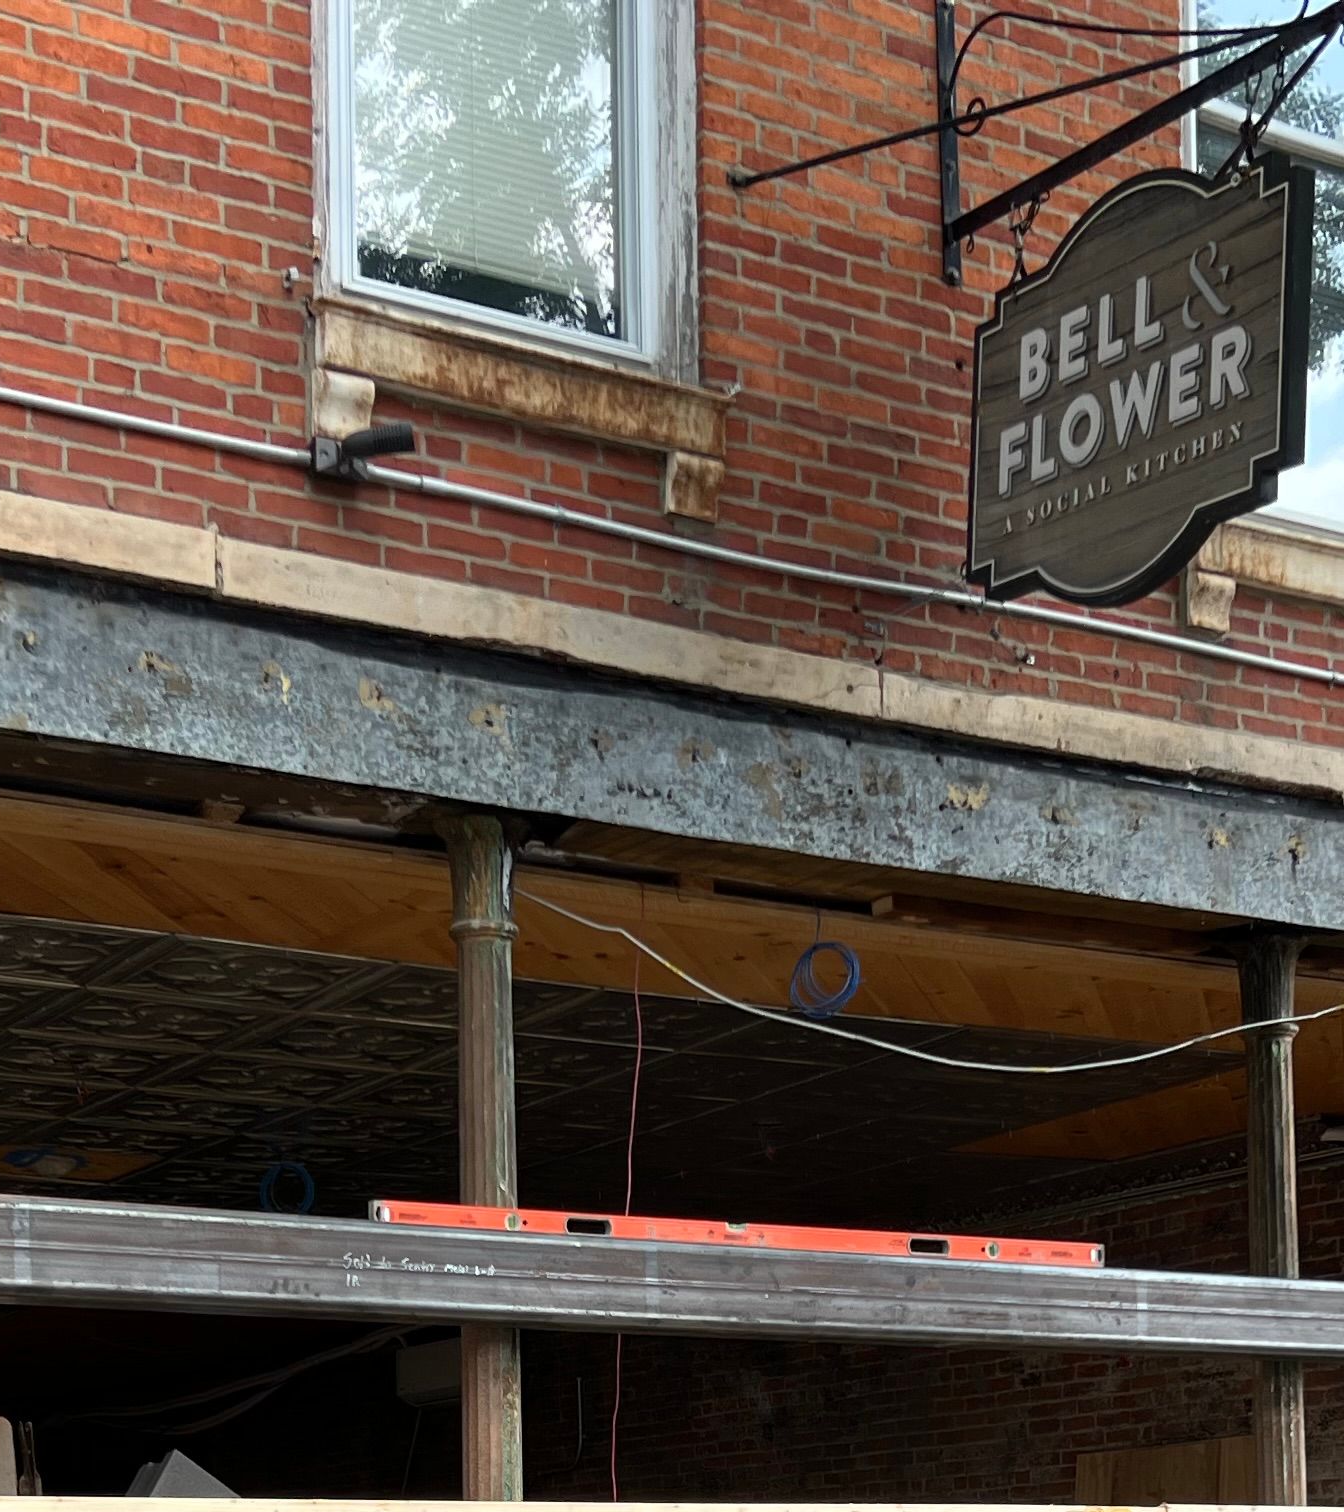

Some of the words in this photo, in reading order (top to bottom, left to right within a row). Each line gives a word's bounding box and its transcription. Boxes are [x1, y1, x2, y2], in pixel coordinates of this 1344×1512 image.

[1018, 275, 1165, 402] BELL
[1182, 240, 1235, 331] &
[998, 324, 1253, 497] FLOWER
[1002, 516, 1013, 536] A
[1027, 475, 1113, 527] SOCIAL
[1126, 421, 1246, 486] KITCHEN
